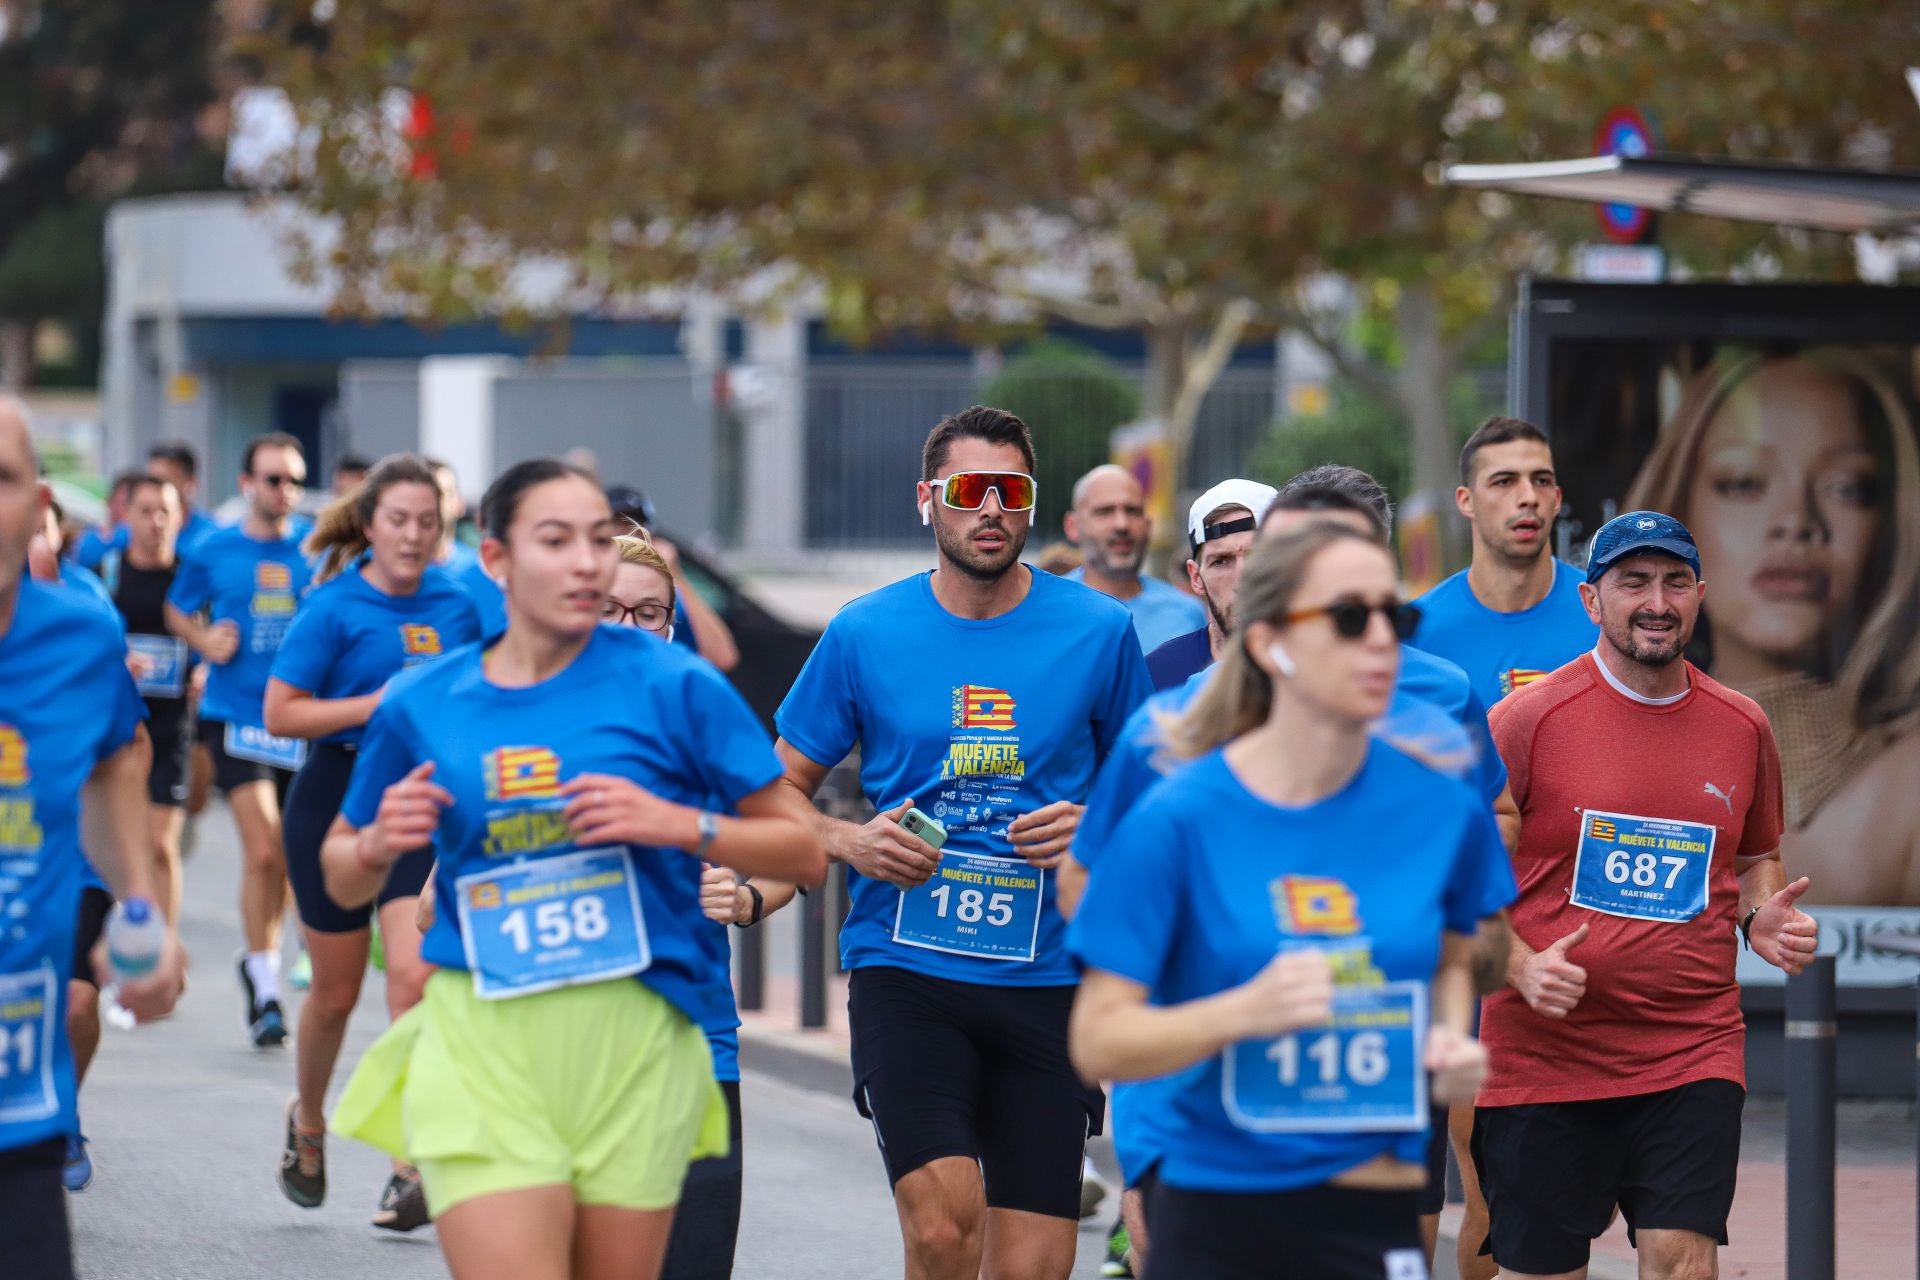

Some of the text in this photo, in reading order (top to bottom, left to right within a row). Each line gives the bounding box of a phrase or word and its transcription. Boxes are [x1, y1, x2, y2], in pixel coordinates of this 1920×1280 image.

[949, 740, 1019, 760] MUÉVETE
[942, 760, 1025, 776] X VALENCIA
[1618, 833, 1706, 853] MUÉVETE X VALENCIA
[941, 867, 1036, 889] MUÉVETE X VALENCIA
[1604, 850, 1687, 889] 687
[1620, 889, 1664, 900] MARTINEZ
[930, 885, 1014, 926] 185
[500, 895, 609, 953] 158
[956, 926, 977, 935] MIKI
[1265, 1031, 1390, 1086] 116
